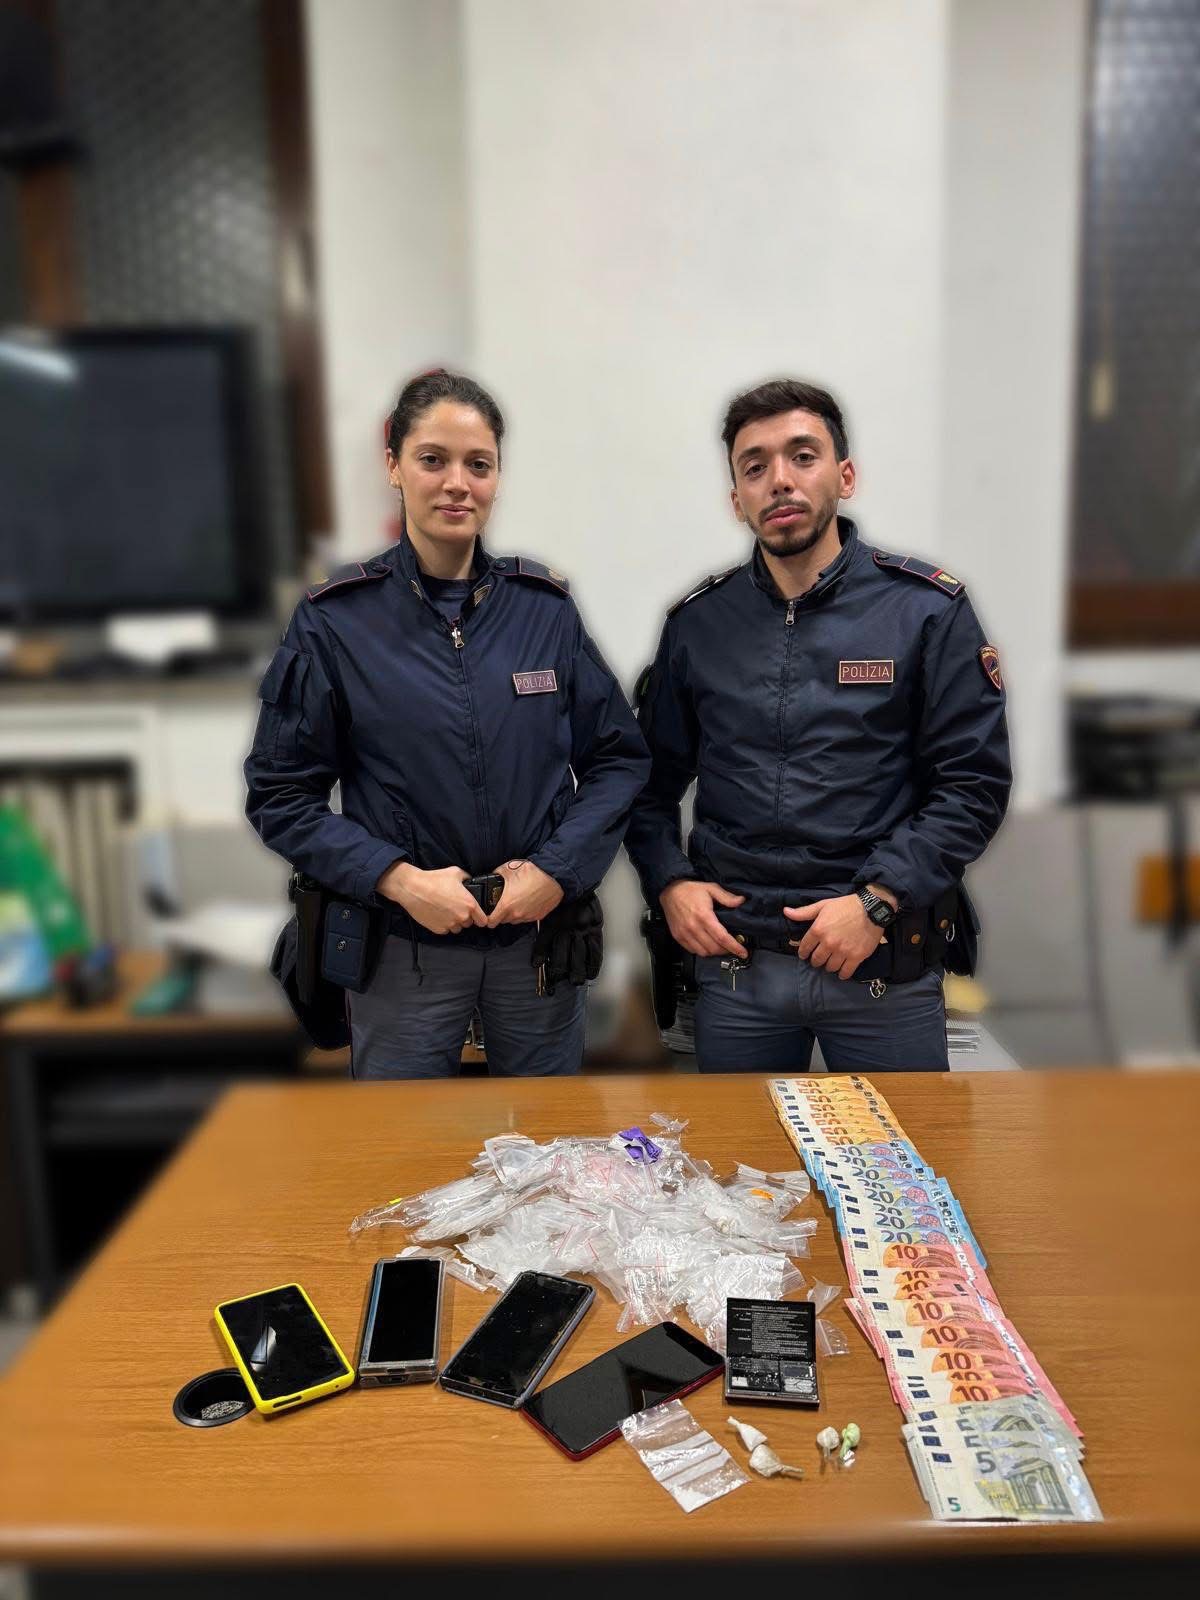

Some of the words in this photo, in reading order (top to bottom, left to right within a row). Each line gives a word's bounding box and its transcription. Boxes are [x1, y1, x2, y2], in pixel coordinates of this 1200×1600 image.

[842, 666, 890, 678] POLIZIA
[516, 675, 553, 688] POLIZIA
[852, 1166, 879, 1180] 20
[865, 1188, 894, 1203] 20
[875, 1213, 905, 1229] 20
[880, 1230, 912, 1244] 20
[891, 1245, 919, 1260] 10
[913, 1302, 943, 1320] 10
[926, 1326, 958, 1344] 10
[938, 1352, 971, 1369] 10
[955, 1386, 989, 1401] 10
[976, 1451, 996, 1474] 5
[948, 1497, 961, 1512] 5
